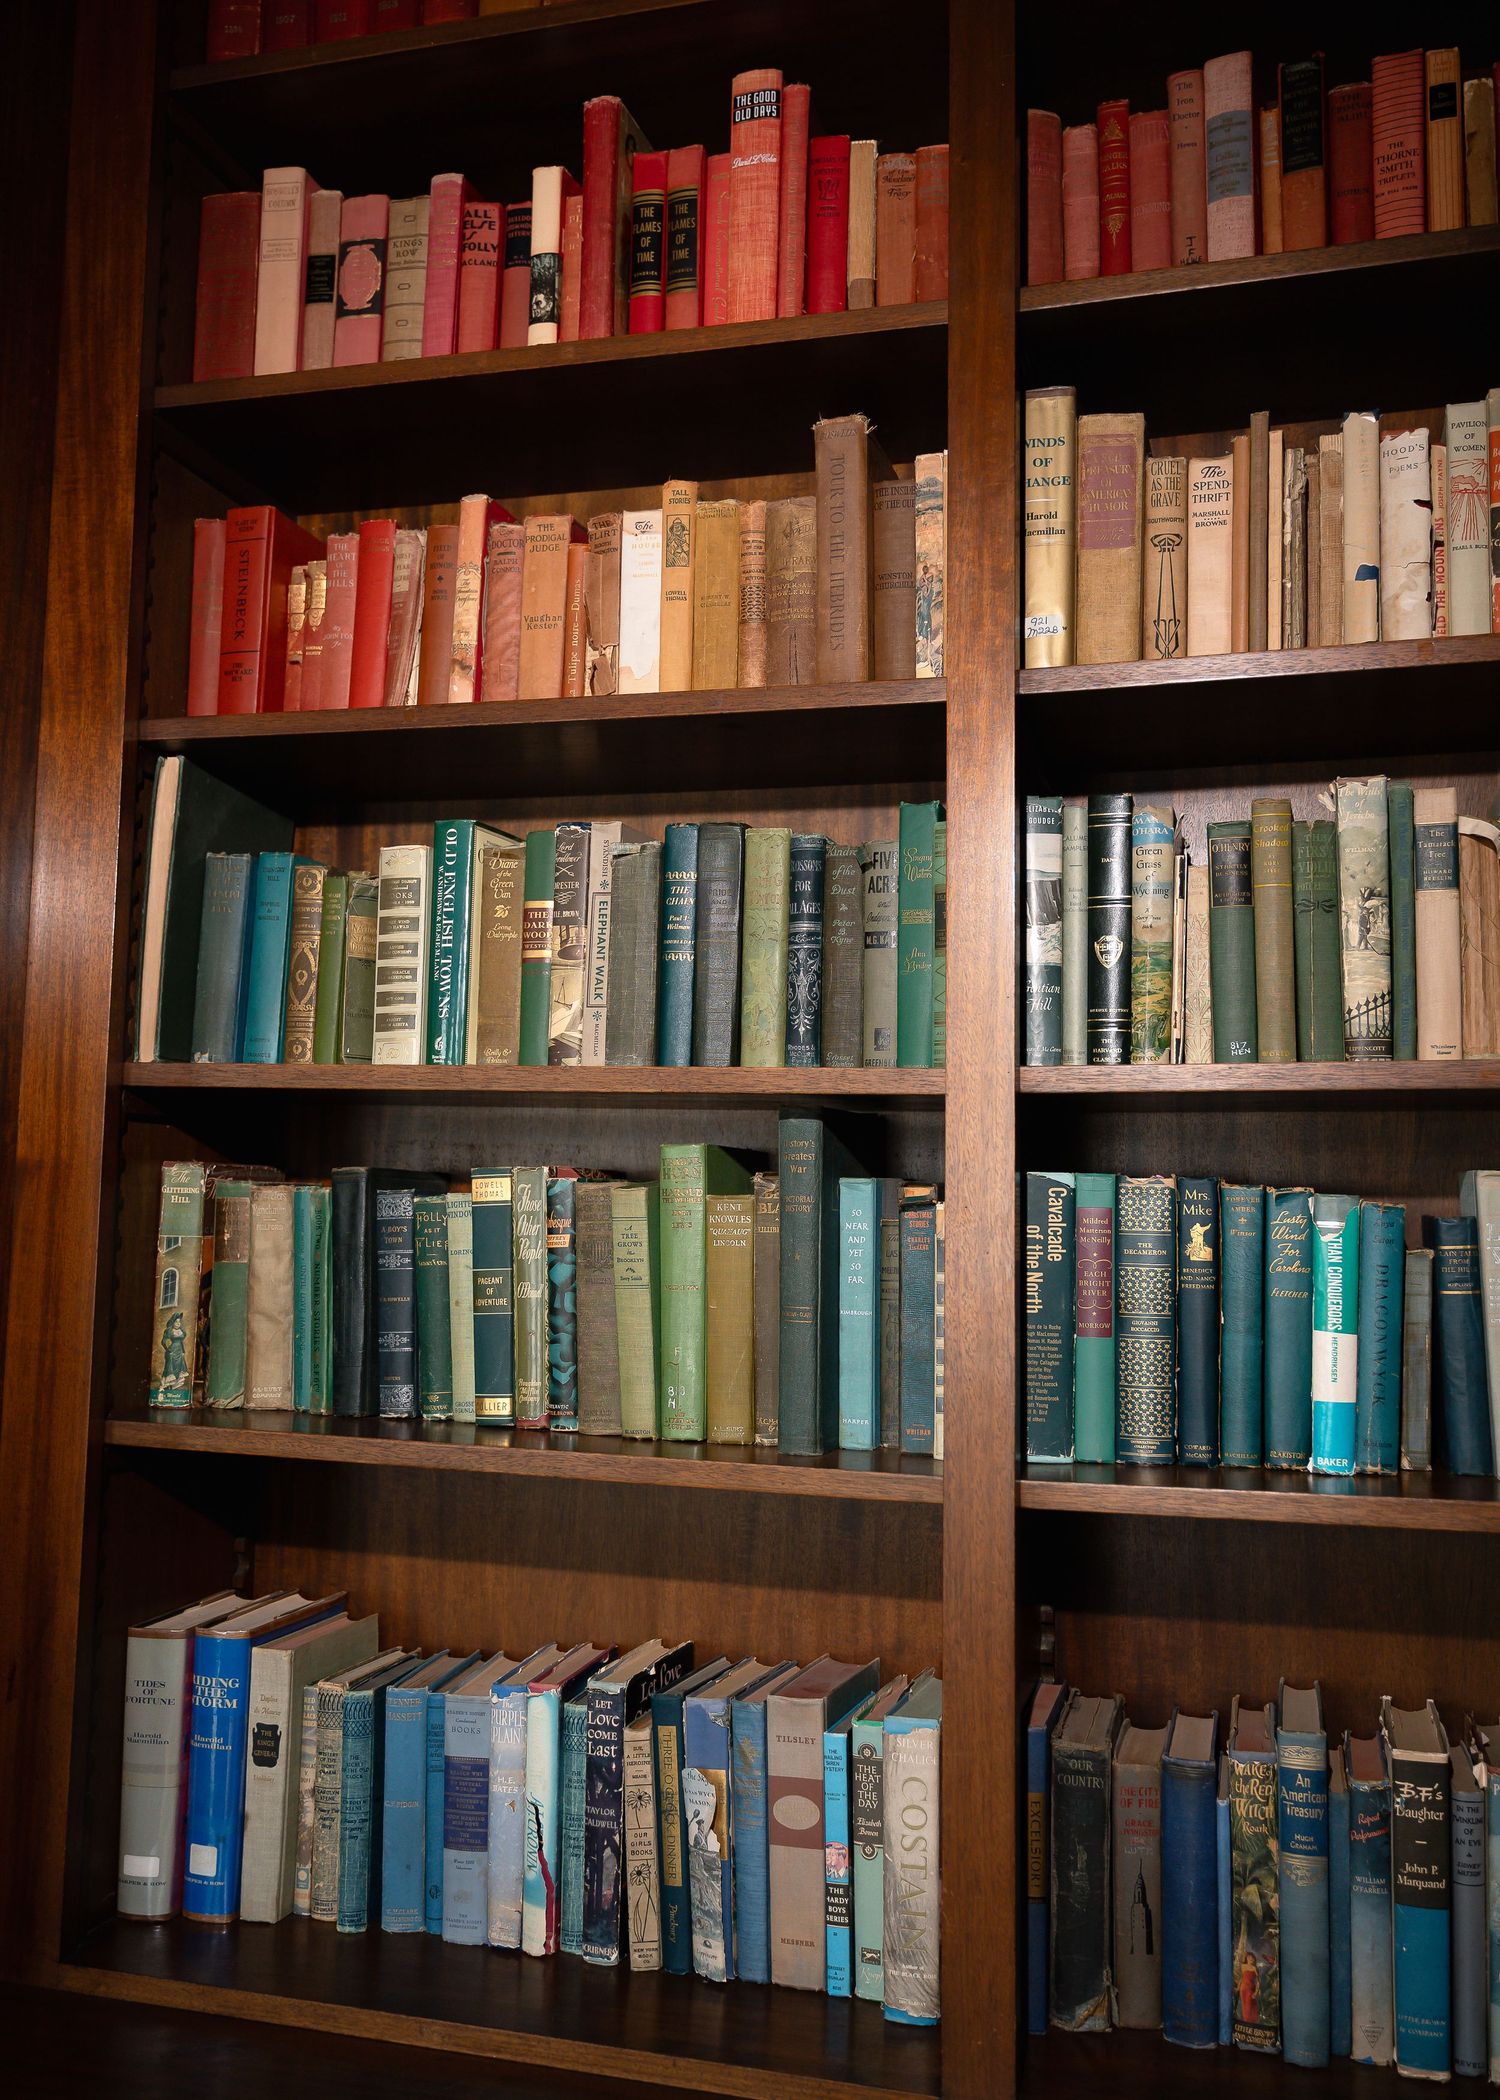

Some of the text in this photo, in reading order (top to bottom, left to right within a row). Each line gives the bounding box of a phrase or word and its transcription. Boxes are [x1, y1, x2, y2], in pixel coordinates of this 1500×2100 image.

[736, 90, 777, 107] THE GOOD
[735, 105, 777, 122] OLD DAYS
[1387, 140, 1404, 150] THE
[1375, 149, 1420, 165] THORNE
[1380, 161, 1414, 175] SMITH
[1378, 173, 1416, 185] TRIPLETS
[640, 207, 655, 218] THE
[675, 202, 689, 214] THE
[464, 209, 492, 219] ALL
[463, 220, 496, 231] ELSE
[633, 221, 662, 234] FLAMES
[392, 238, 423, 249] KINGS
[640, 236, 652, 248] OF
[675, 233, 686, 244] OF
[462, 242, 498, 253] FOLLY
[636, 251, 655, 263] TIME
[672, 248, 690, 261] TIME
[1451, 420, 1488, 430] PAVILION
[1465, 432, 1475, 440] OF
[1032, 458, 1053, 468] OF
[1151, 461, 1182, 476] CRUEL
[1201, 465, 1227, 479] The
[1151, 477, 1182, 491] AS THE
[1151, 492, 1181, 508] GRAVE
[1193, 492, 1231, 504] THRIFT
[1026, 511, 1058, 521] Harold
[537, 524, 555, 532] THE
[635, 520, 653, 531] The
[525, 533, 567, 544] PRODIGAL
[590, 529, 619, 542] FLIRT
[530, 543, 561, 553] JUDGE
[829, 455, 846, 651] TOUR TO THE HEBRIDES
[233, 550, 251, 641] STEINBECK
[524, 614, 563, 624] Vaughan
[1028, 817, 1055, 825] GOUDGE
[1344, 808, 1375, 823] Jericho
[1132, 827, 1170, 836] O'HARA
[1253, 823, 1290, 834] Crooked
[1255, 839, 1288, 848] Shadow
[1418, 840, 1455, 849] Tamarack
[1136, 847, 1163, 856] Green
[1428, 850, 1446, 859] Tree
[489, 859, 518, 870] Diane
[1136, 860, 1162, 869] Grass
[670, 886, 690, 895] THE
[794, 880, 811, 892] FOR
[528, 911, 548, 919] THE
[438, 828, 458, 1019] OLD ENGLISH TOWNS
[524, 921, 553, 929] DARK
[594, 900, 608, 1001] ELEPHANT WALK
[1029, 998, 1052, 1011] Hill
[790, 1164, 807, 1174] War
[171, 1170, 190, 1183] The
[162, 1186, 200, 1194] GLITTERING
[475, 1181, 504, 1190] LOWELL
[171, 1195, 190, 1204] HILL
[475, 1190, 504, 1198] THOMAS
[517, 1184, 542, 1212] Those
[717, 1203, 742, 1211] KENT
[1183, 1204, 1212, 1216] Mike
[709, 1214, 751, 1224] KNOWLES
[852, 1209, 862, 1218] SO
[517, 1214, 540, 1236] Other
[1048, 1188, 1068, 1262] Cavalcade
[1083, 1217, 1108, 1225] Mildred
[1270, 1212, 1308, 1228] Lusty
[845, 1223, 868, 1231] NEAR
[1272, 1227, 1306, 1241] Wind
[847, 1236, 866, 1244] AND
[518, 1241, 543, 1264] People
[849, 1249, 863, 1258] YET
[1279, 1243, 1302, 1257] For
[1027, 1243, 1044, 1269] the
[850, 1263, 861, 1271] SO
[1269, 1259, 1311, 1274] Carolina
[1084, 1270, 1107, 1278] EACH
[478, 1277, 503, 1285] PAGEANT
[848, 1276, 864, 1285] FAR
[1079, 1279, 1111, 1287] BRIGHT
[486, 1287, 494, 1295] OF
[1027, 1271, 1044, 1315] North
[1082, 1289, 1107, 1297] RIVER
[1271, 1289, 1308, 1299] FLETCHER
[1327, 1267, 1342, 1331] CONQUERORS
[1079, 1322, 1111, 1330] MORROW
[1371, 1264, 1390, 1407] DRAGONWYCK
[1330, 1337, 1338, 1384] HENDRIKSEN
[1317, 1457, 1348, 1467] BAKER
[134, 1680, 166, 1689] TIDES
[142, 1688, 157, 1697] OF
[197, 1686, 227, 1699] THE
[594, 1700, 613, 1710] LET
[491, 1708, 525, 1726] PURPLE
[451, 1726, 481, 1735] BOOKS
[492, 1725, 522, 1744] PLAIN
[588, 1730, 618, 1740] COME
[776, 1735, 816, 1745] TILSLEY
[896, 1737, 934, 1750] SILVER
[661, 1733, 672, 1772] THREE
[858, 1765, 877, 1775] THE
[1070, 1759, 1093, 1772] OUR
[855, 1772, 881, 1784] HEAT
[1058, 1774, 1104, 1789] COUNTRY
[1296, 1774, 1311, 1787] An
[861, 1782, 874, 1792] OF
[858, 1791, 878, 1800] THE
[1282, 1787, 1327, 1803] American
[858, 1800, 878, 1809] DAY
[585, 1806, 615, 1816] TAYLOR
[1285, 1801, 1325, 1820] Treasury
[1464, 1828, 1474, 1836] OF
[665, 1832, 677, 1880] DINNER
[900, 1777, 928, 1951] COSTAIN
[1404, 1862, 1428, 1875] John
[1355, 1876, 1386, 1885] WILLIAM
[1395, 1875, 1446, 1891] Marquand
[829, 1887, 844, 1895] THE
[828, 1906, 846, 1914] BOYS
[826, 1915, 849, 1923] SERIES
